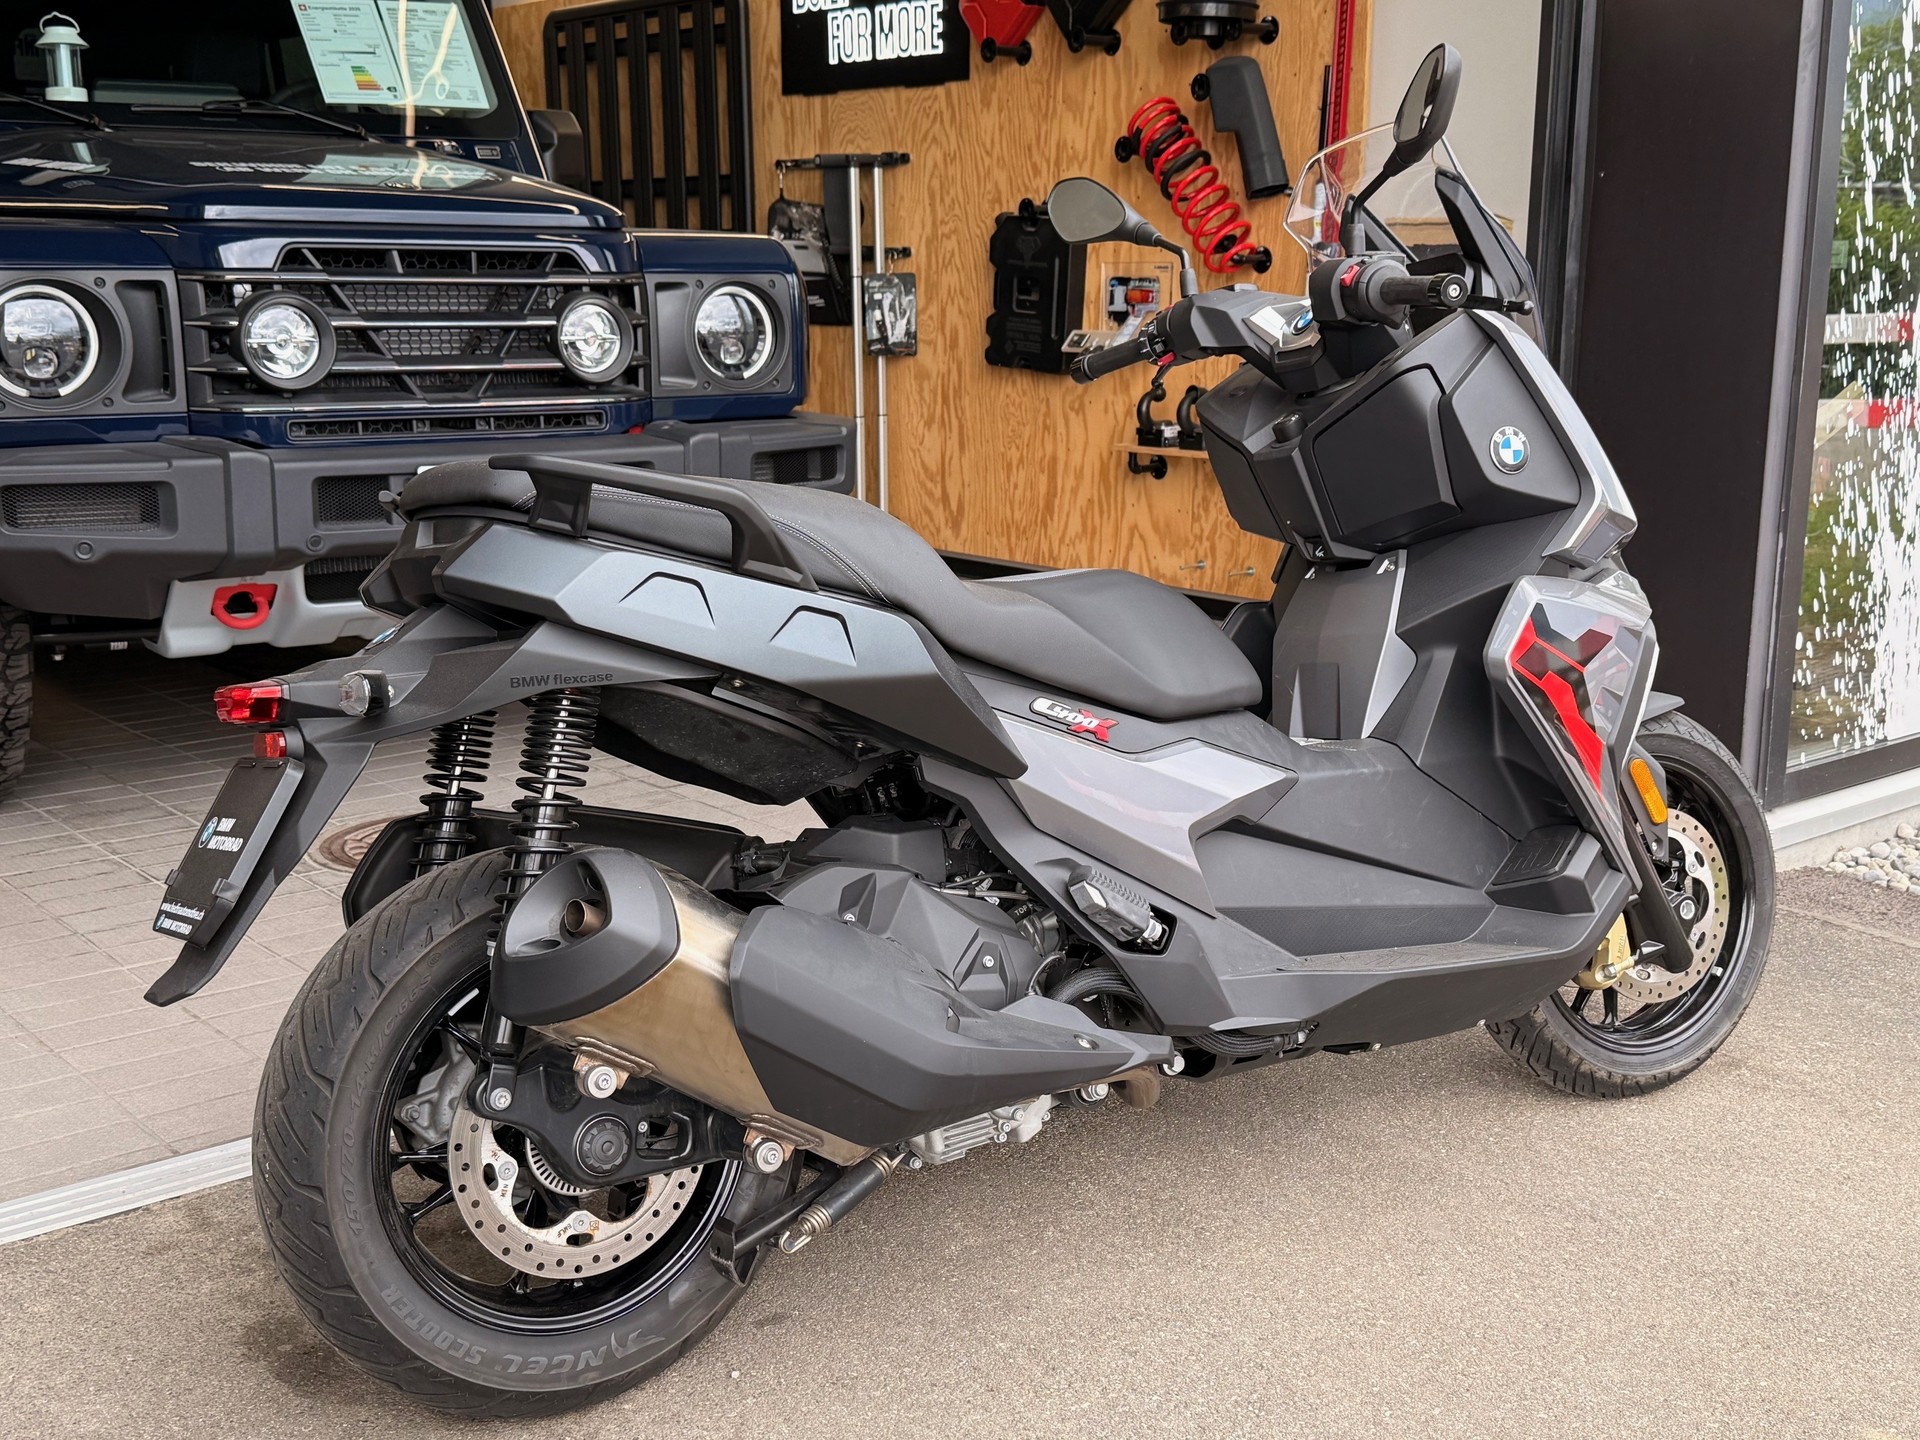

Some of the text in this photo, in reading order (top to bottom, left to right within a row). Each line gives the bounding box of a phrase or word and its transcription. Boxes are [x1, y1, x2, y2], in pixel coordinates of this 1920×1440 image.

[827, 0, 944, 65] FOR MORE
[1494, 427, 1527, 443] BMW
[510, 672, 614, 688] BMW flexcase
[216, 818, 236, 832] BMW
[206, 835, 243, 852] MOTORRAD
[1014, 904, 1028, 916] TOP
[380, 1283, 487, 1365] SCOOTER
